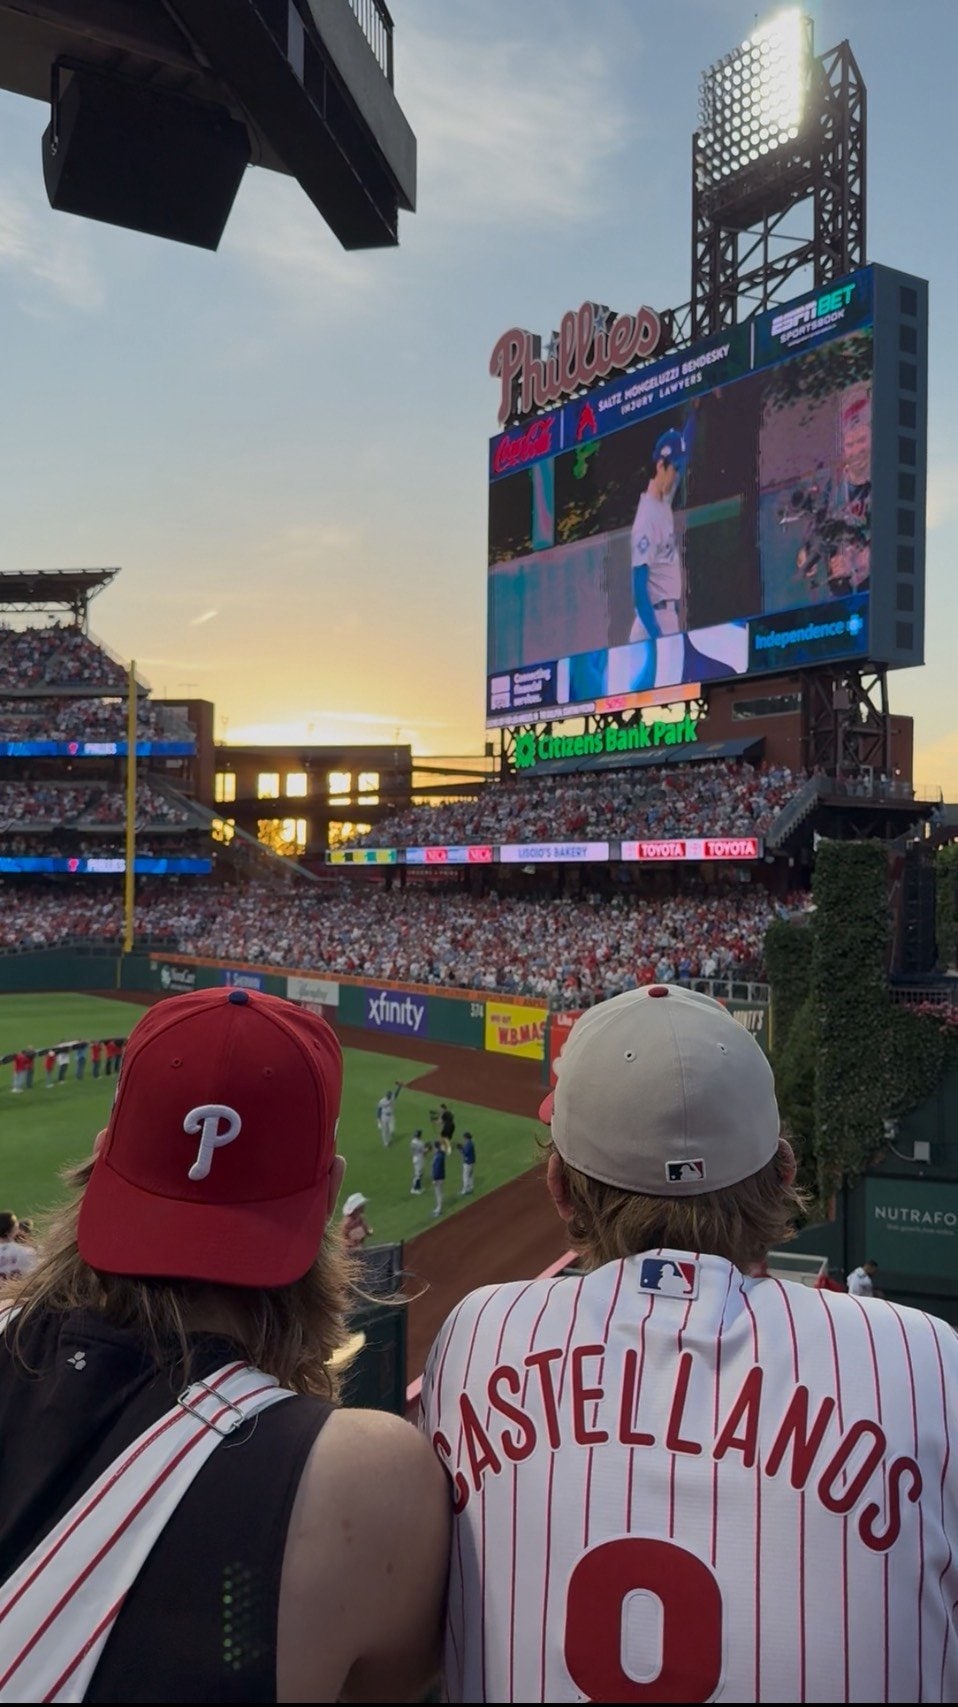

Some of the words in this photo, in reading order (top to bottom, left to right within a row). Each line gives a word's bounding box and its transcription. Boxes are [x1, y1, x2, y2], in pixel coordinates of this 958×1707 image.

[780, 308, 846, 343] SPORTSBOOK
[489, 300, 662, 428] Phillies
[598, 391, 622, 412] SALTZ
[681, 344, 731, 375] BENDESKY
[620, 393, 654, 416] INJURY
[659, 372, 703, 398] LAWYERS
[755, 620, 845, 650] Independence
[536, 732, 603, 761] Citizens
[604, 722, 651, 752] Bank
[653, 713, 698, 746] Park
[553, 846, 588, 858] BAKERY
[640, 842, 684, 858] TOYOTA
[706, 840, 755, 857] TOYOTA
[368, 991, 425, 1031] xfinity
[183, 1104, 242, 1181] P
[874, 1206, 957, 1226] NUTRAFO
